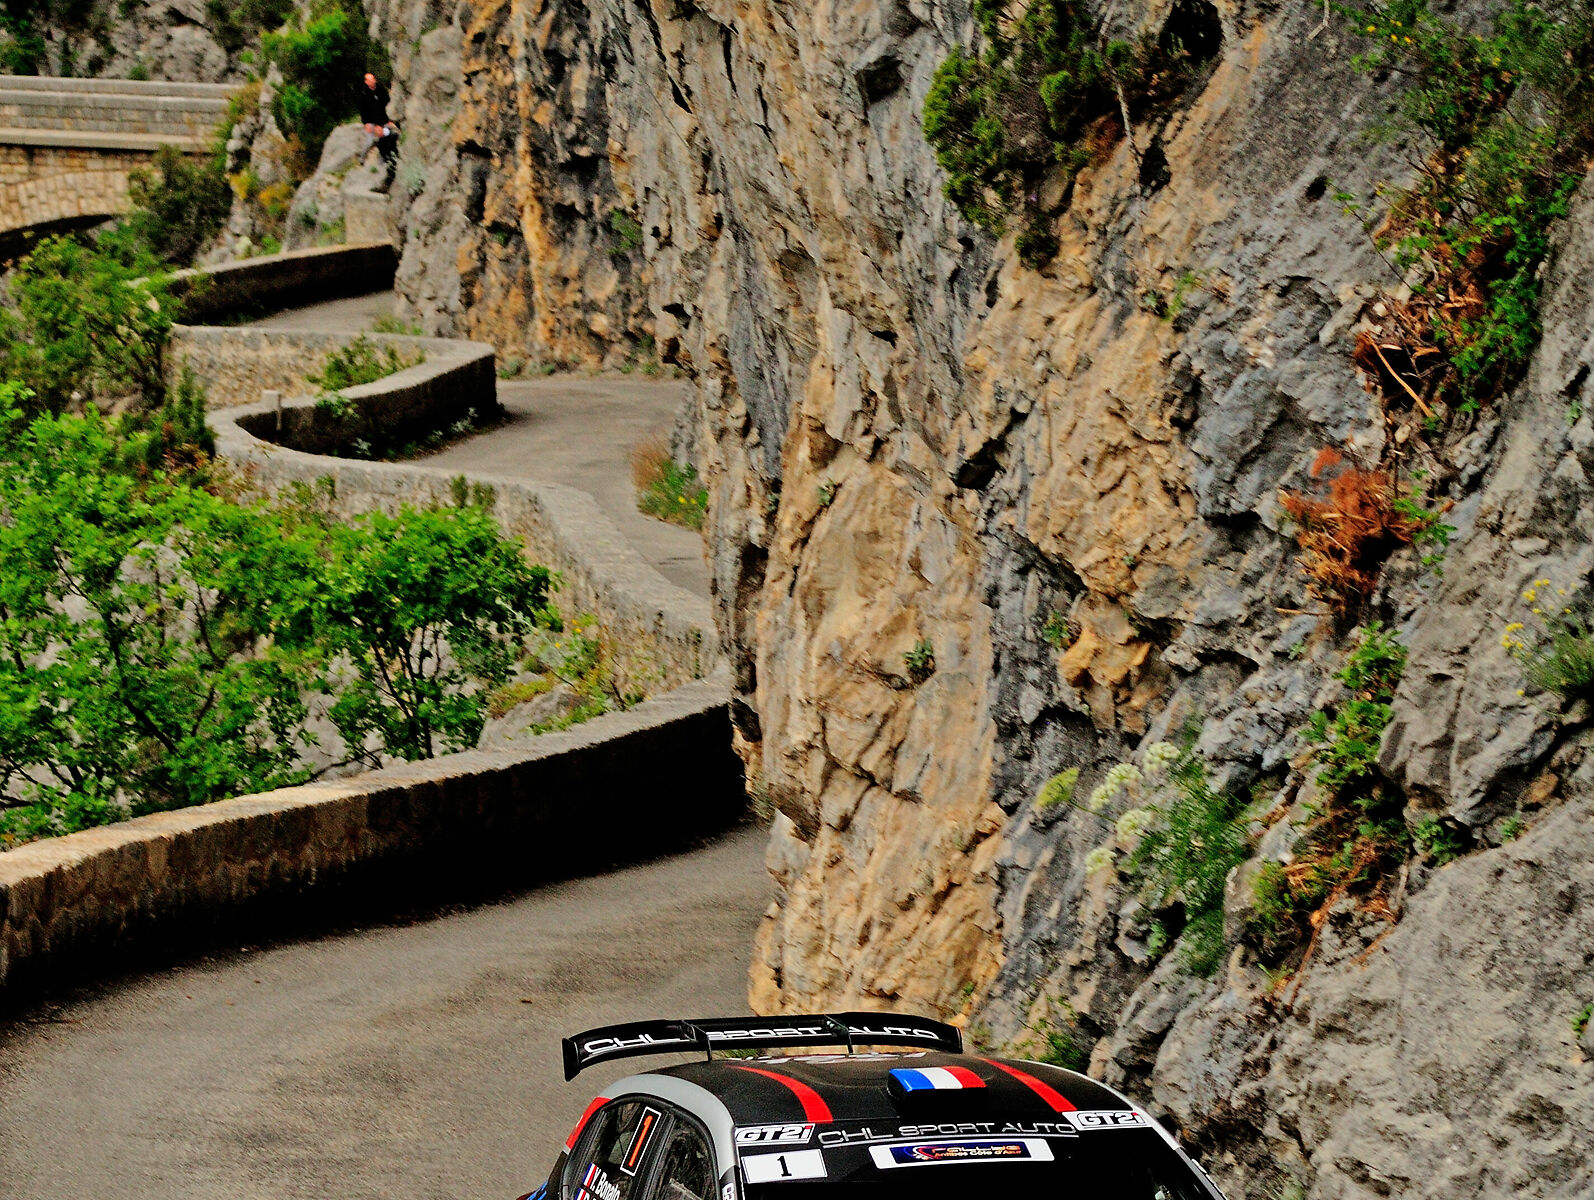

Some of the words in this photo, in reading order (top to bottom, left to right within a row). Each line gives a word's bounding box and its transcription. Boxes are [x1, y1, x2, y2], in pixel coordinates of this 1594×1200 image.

[584, 1034, 681, 1054] CHL
[737, 1125, 813, 1142] GT2i
[818, 1127, 893, 1145] CHL
[899, 1122, 995, 1137] SPORT
[1002, 1122, 1077, 1135] AUTO
[1077, 1112, 1147, 1127] GT2i
[777, 1155, 792, 1178] 1
